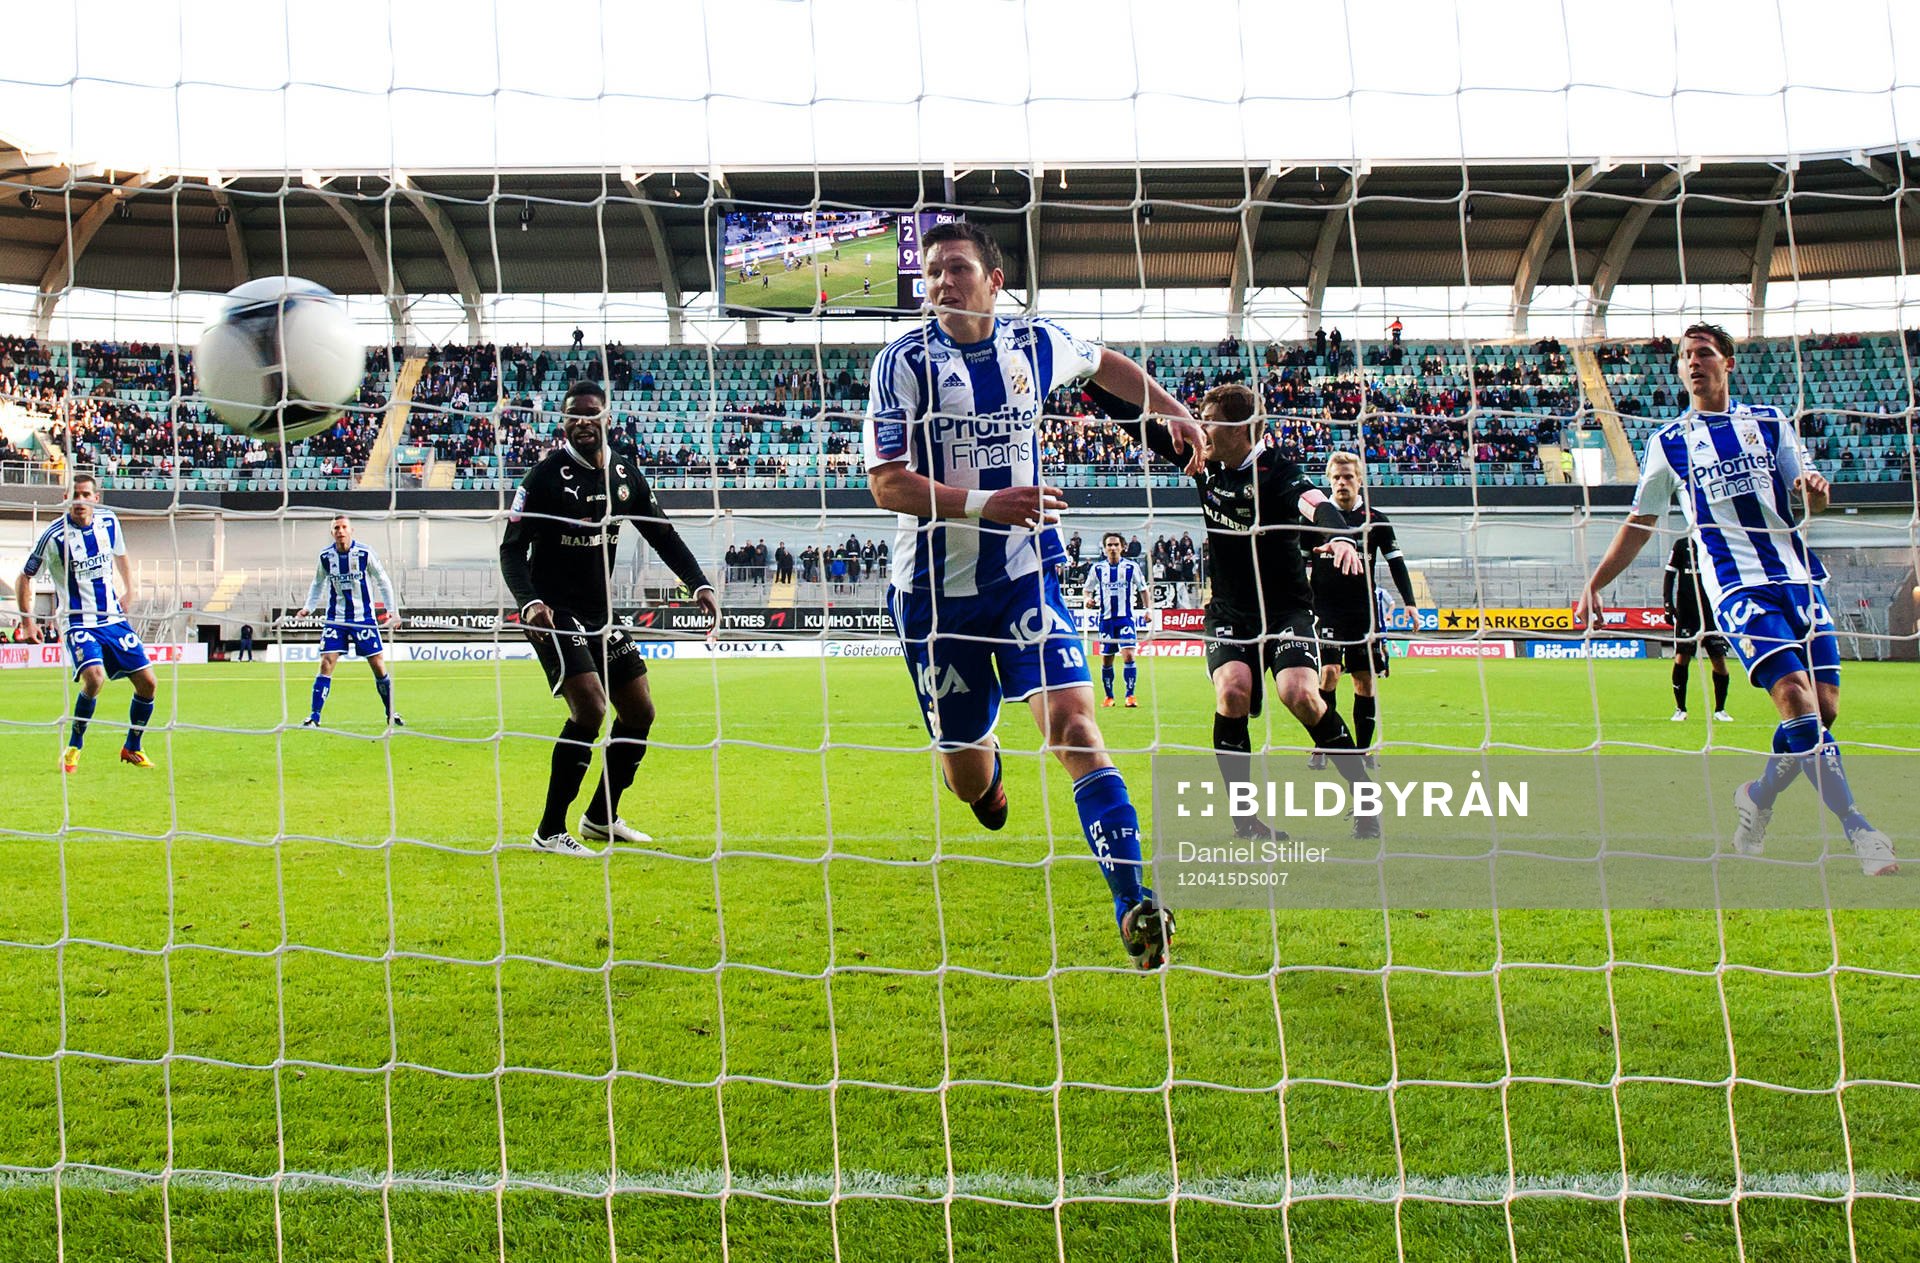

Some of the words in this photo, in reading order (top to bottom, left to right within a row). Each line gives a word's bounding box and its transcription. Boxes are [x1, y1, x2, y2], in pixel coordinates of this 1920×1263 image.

[901, 215, 914, 224] IFK
[903, 225, 914, 242] 2
[942, 380, 966, 388] adidas
[952, 442, 1029, 469] Finans
[1693, 451, 1776, 486] Prioritet
[1709, 474, 1770, 500] Finans
[410, 615, 459, 628] KUMHO
[460, 615, 501, 628] TYRES
[672, 615, 714, 628] KUMH
[723, 615, 765, 628] TYRES
[804, 615, 854, 628] KUMHO
[1466, 615, 1569, 628] MARKBYGG
[1722, 599, 1767, 632] ICA
[356, 628, 377, 641] ICA
[1009, 604, 1073, 651] ICA
[704, 643, 784, 652] VOLVIA
[1413, 645, 1450, 656] VEST
[1450, 645, 1501, 656] KROSS
[1534, 643, 1639, 659] Björnkläder
[1057, 646, 1084, 668] 19
[916, 662, 971, 700] ICA
